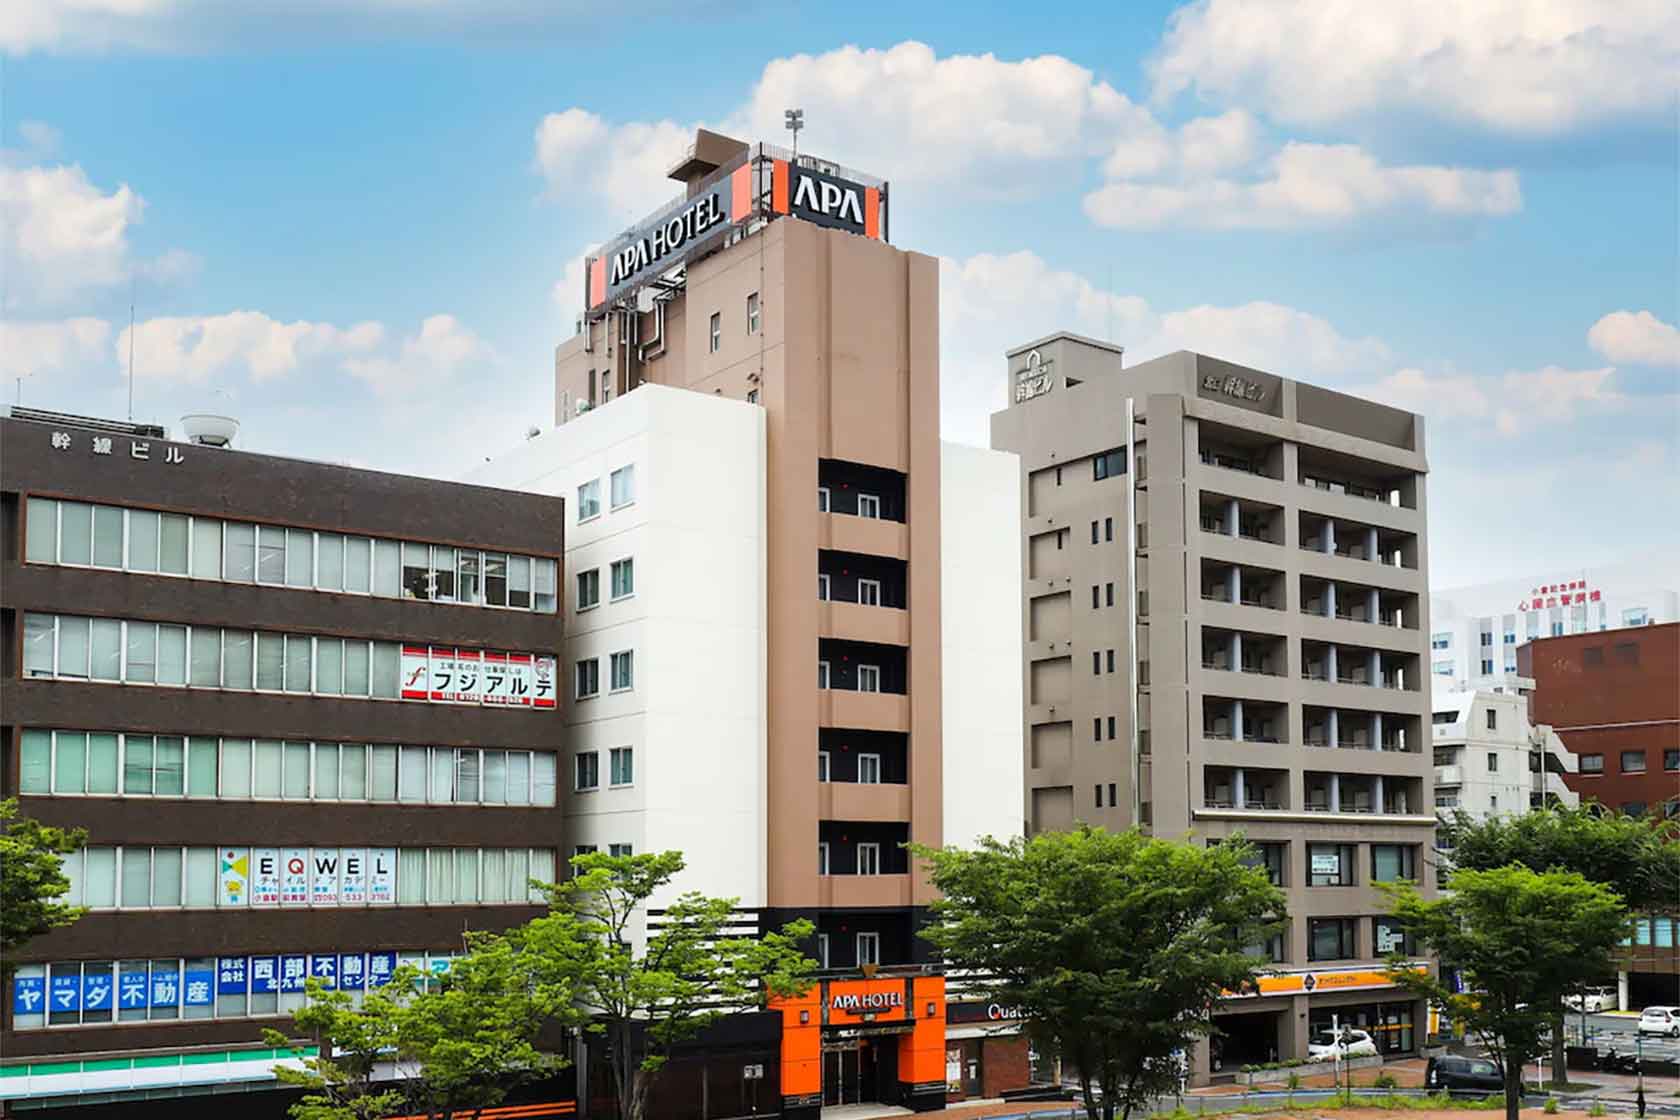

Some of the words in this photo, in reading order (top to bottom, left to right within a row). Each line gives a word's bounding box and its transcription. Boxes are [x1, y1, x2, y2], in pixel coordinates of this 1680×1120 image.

[794, 174, 864, 224] APA
[611, 240, 648, 286] APA
[651, 193, 721, 260] HOTEL
[51, 431, 184, 463] 幹線ビル
[434, 673, 552, 697] フジアルテ
[260, 858, 388, 875] EQWEL
[254, 955, 390, 979] 西部不動産
[18, 981, 210, 1011] ヤマダ不動産
[833, 994, 861, 1009] APA
[862, 992, 904, 1007] HOTEL
